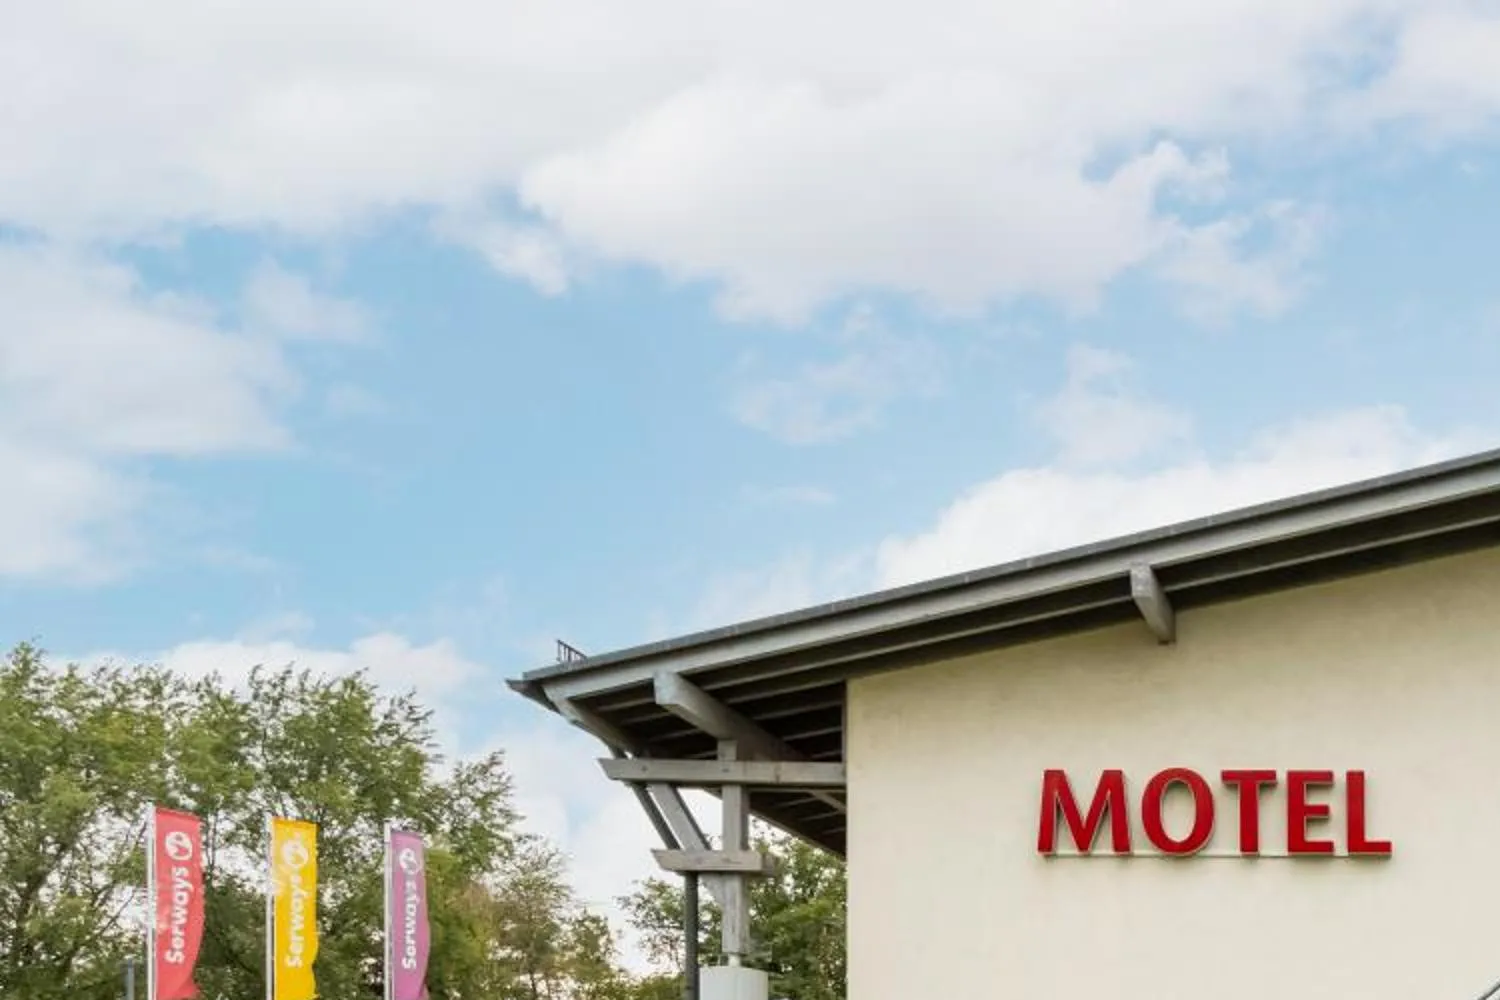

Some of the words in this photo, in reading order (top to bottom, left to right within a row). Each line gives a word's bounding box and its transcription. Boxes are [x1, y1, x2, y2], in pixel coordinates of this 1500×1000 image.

[1037, 767, 1393, 857] MOTEL
[164, 865, 194, 964] Serways
[401, 879, 420, 969] Serways
